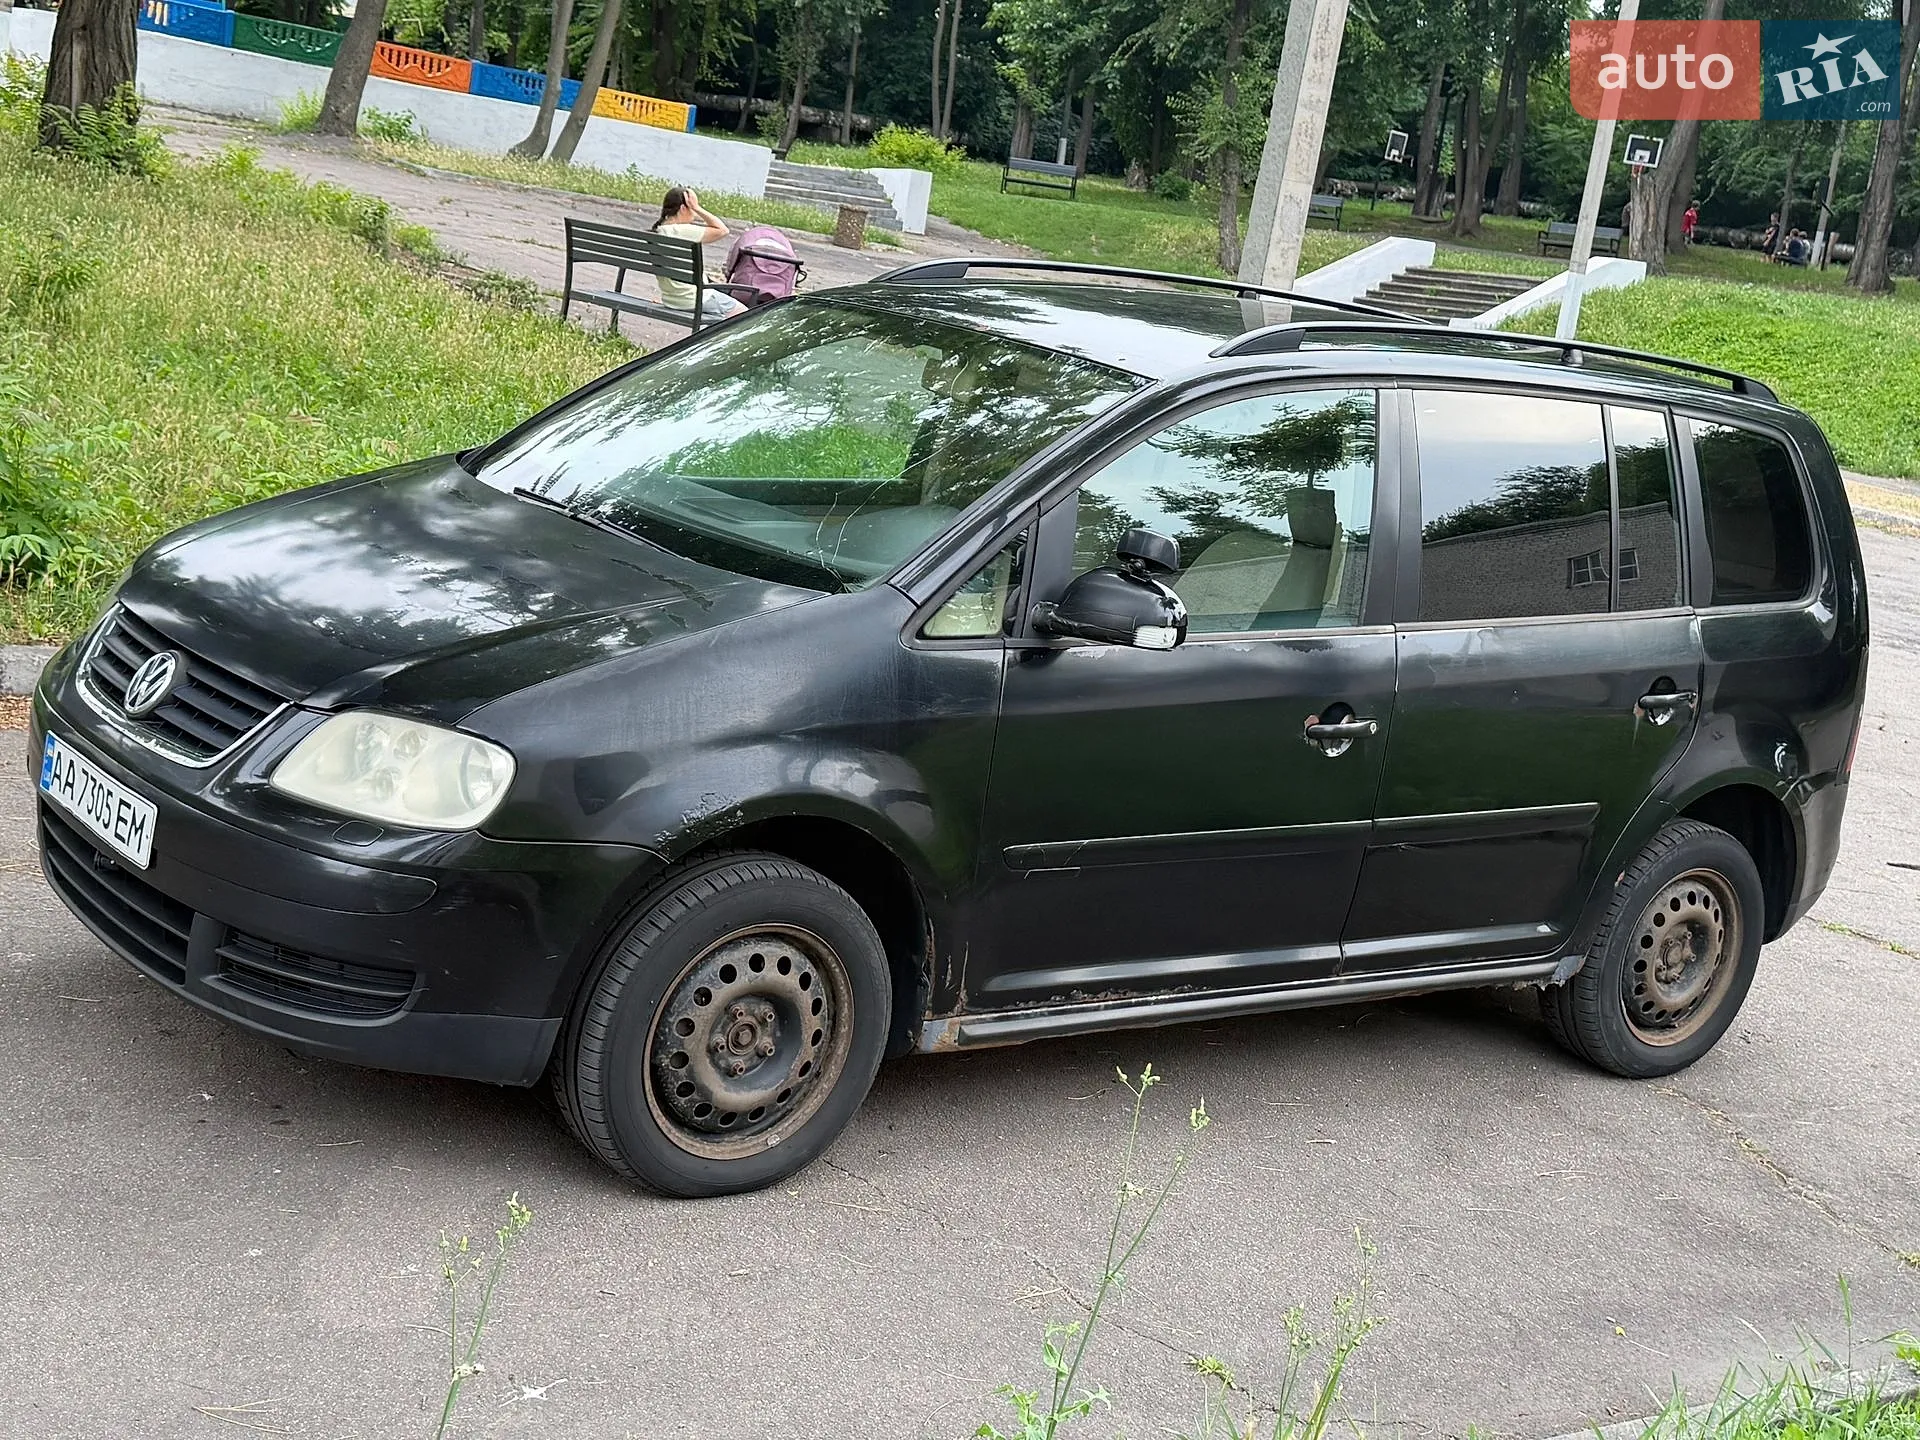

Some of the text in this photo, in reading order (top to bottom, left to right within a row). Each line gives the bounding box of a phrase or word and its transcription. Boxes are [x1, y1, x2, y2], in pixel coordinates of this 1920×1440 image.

[51, 751, 147, 854] AA 7305 EM
